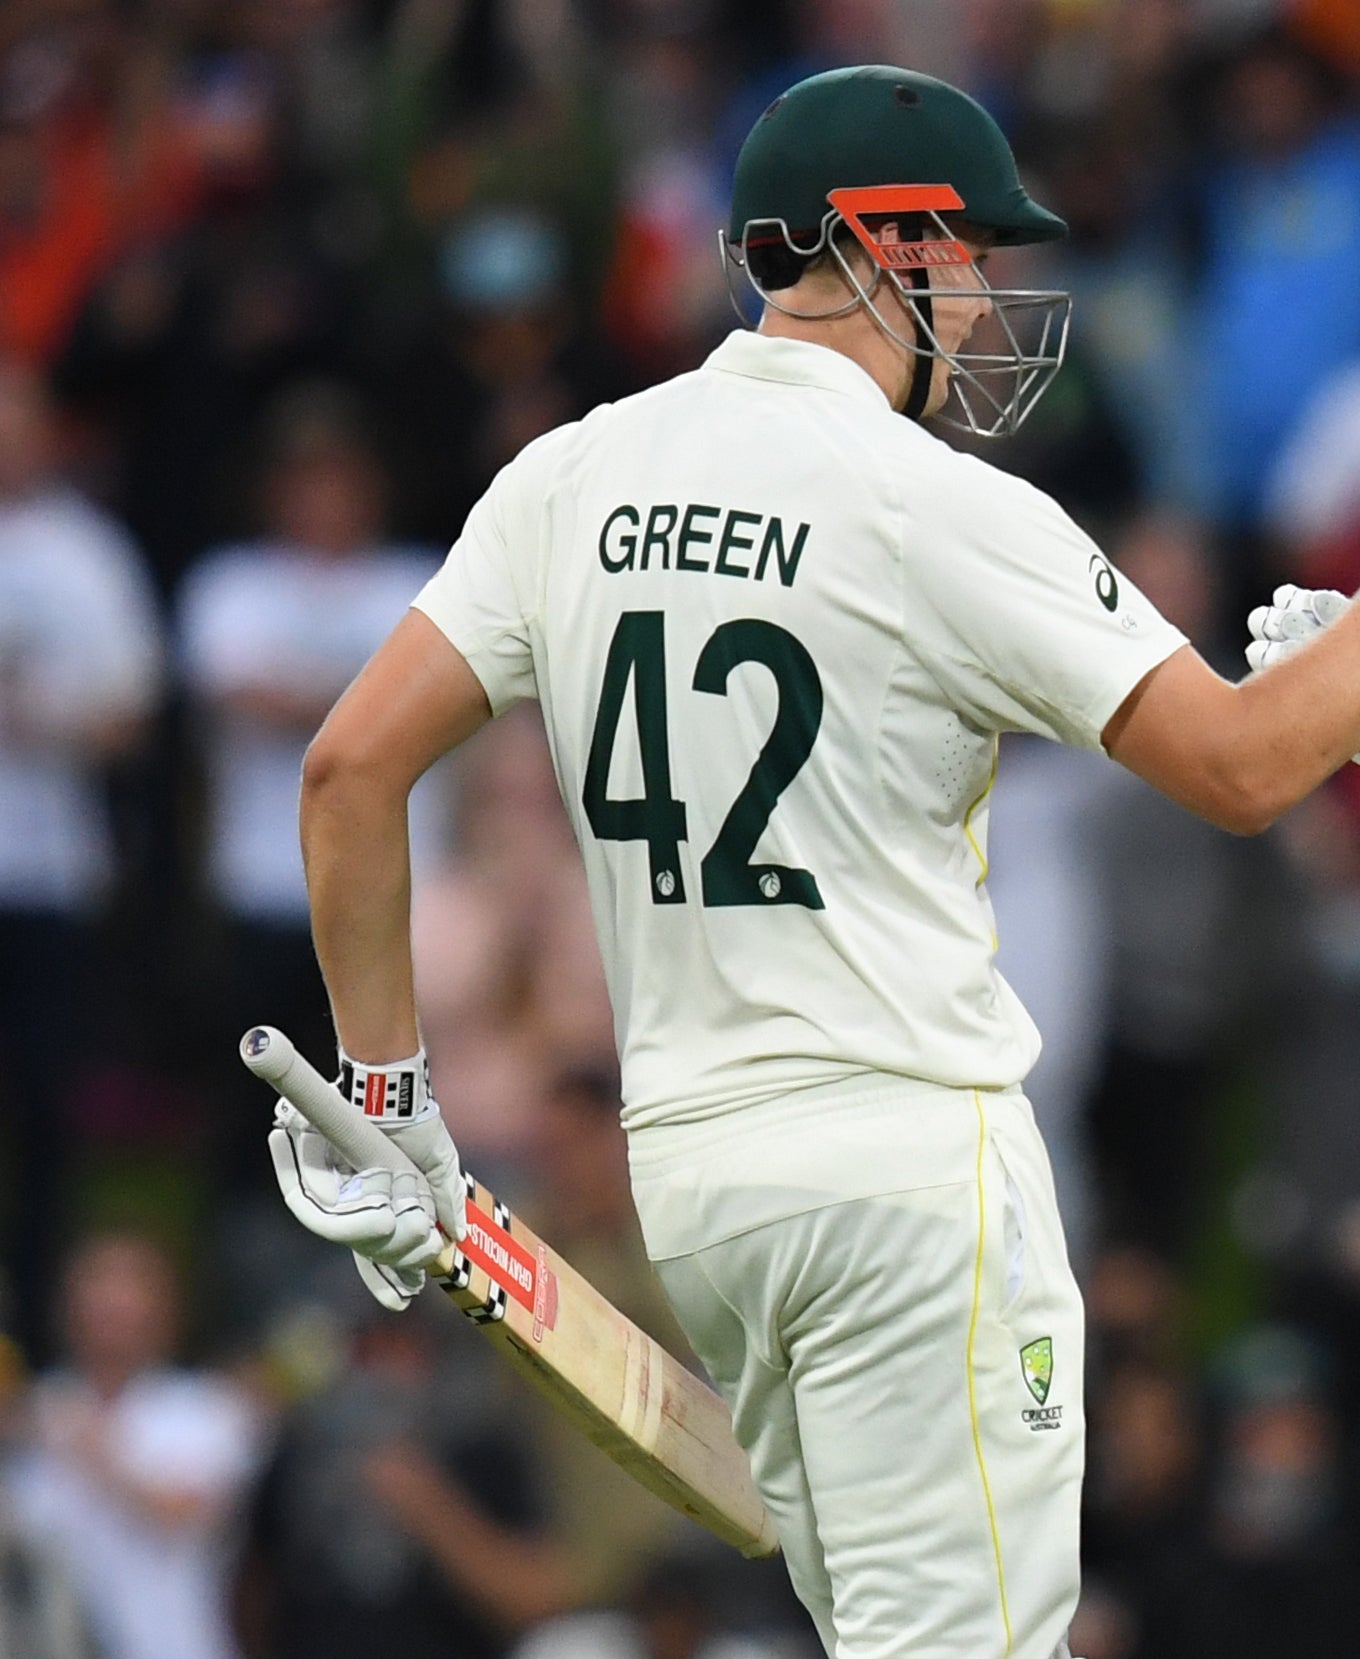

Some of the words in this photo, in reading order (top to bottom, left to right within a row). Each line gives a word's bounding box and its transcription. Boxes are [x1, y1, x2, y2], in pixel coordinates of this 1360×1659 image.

[599, 504, 811, 587] GREEN
[582, 611, 826, 910] 42
[399, 1076, 411, 1110] SILVER
[1021, 1405, 1063, 1422] CRICKET
